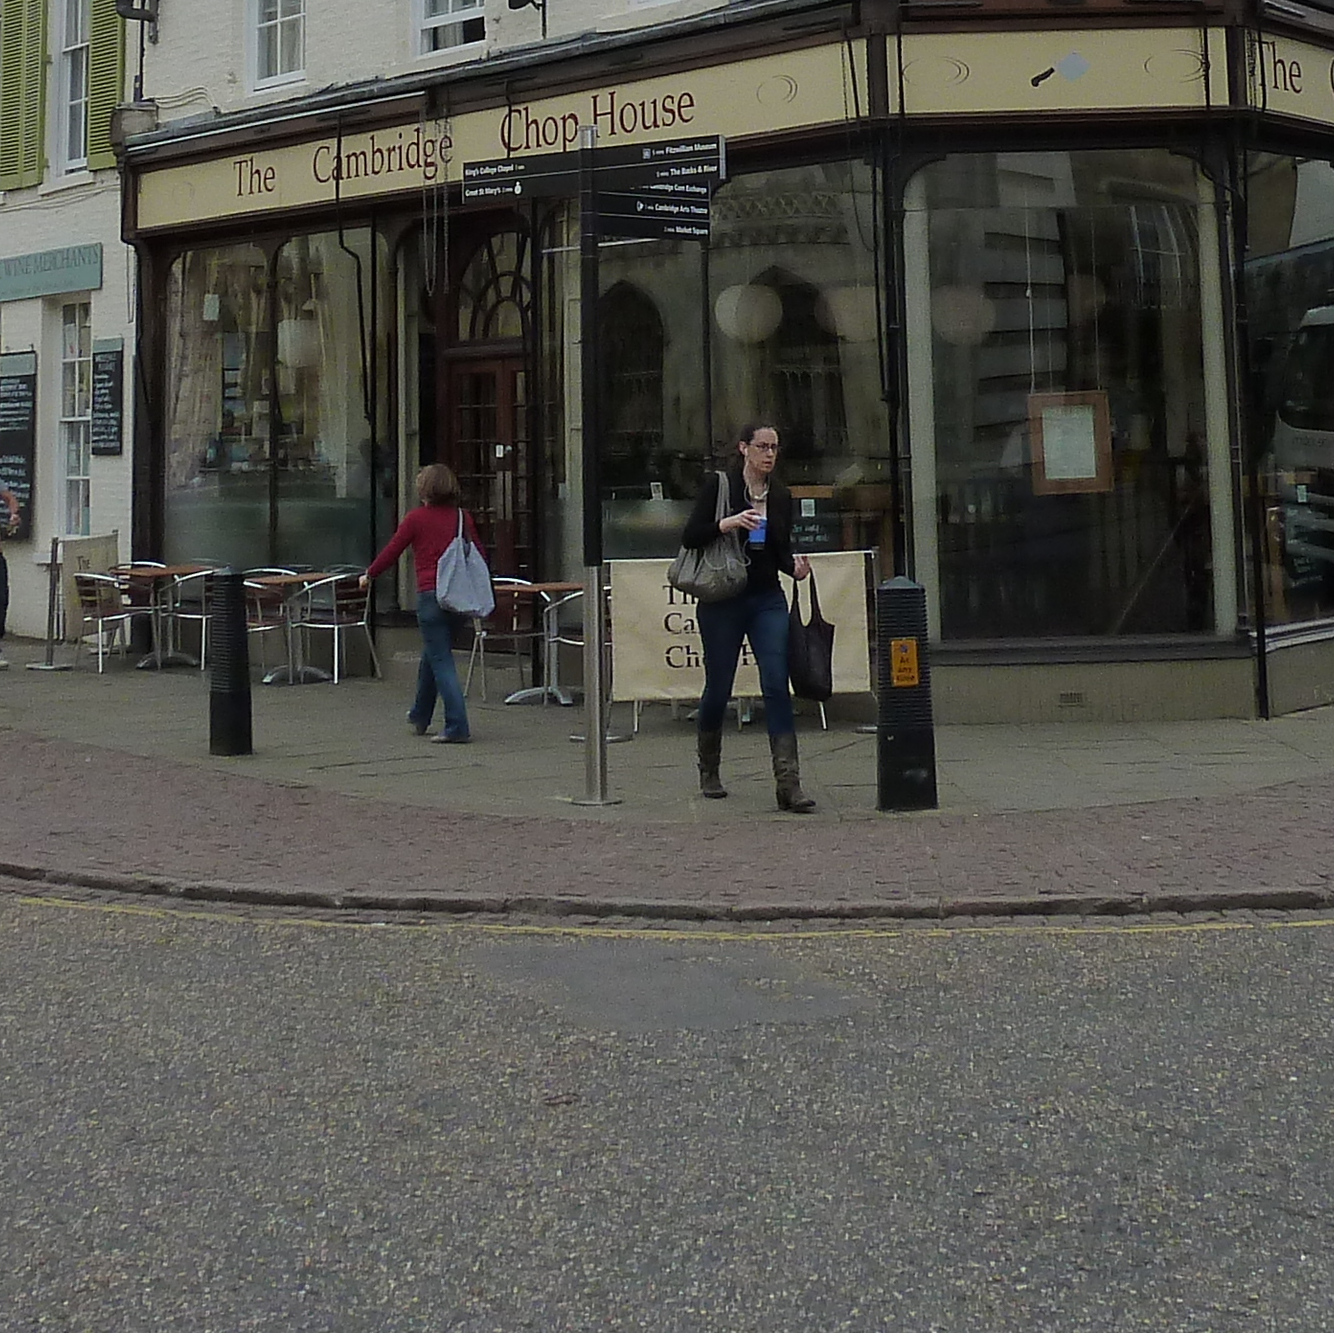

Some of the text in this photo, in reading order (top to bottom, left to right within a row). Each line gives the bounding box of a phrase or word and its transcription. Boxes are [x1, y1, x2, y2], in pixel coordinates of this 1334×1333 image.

[233, 91, 695, 197] The Cambridge Chop House
